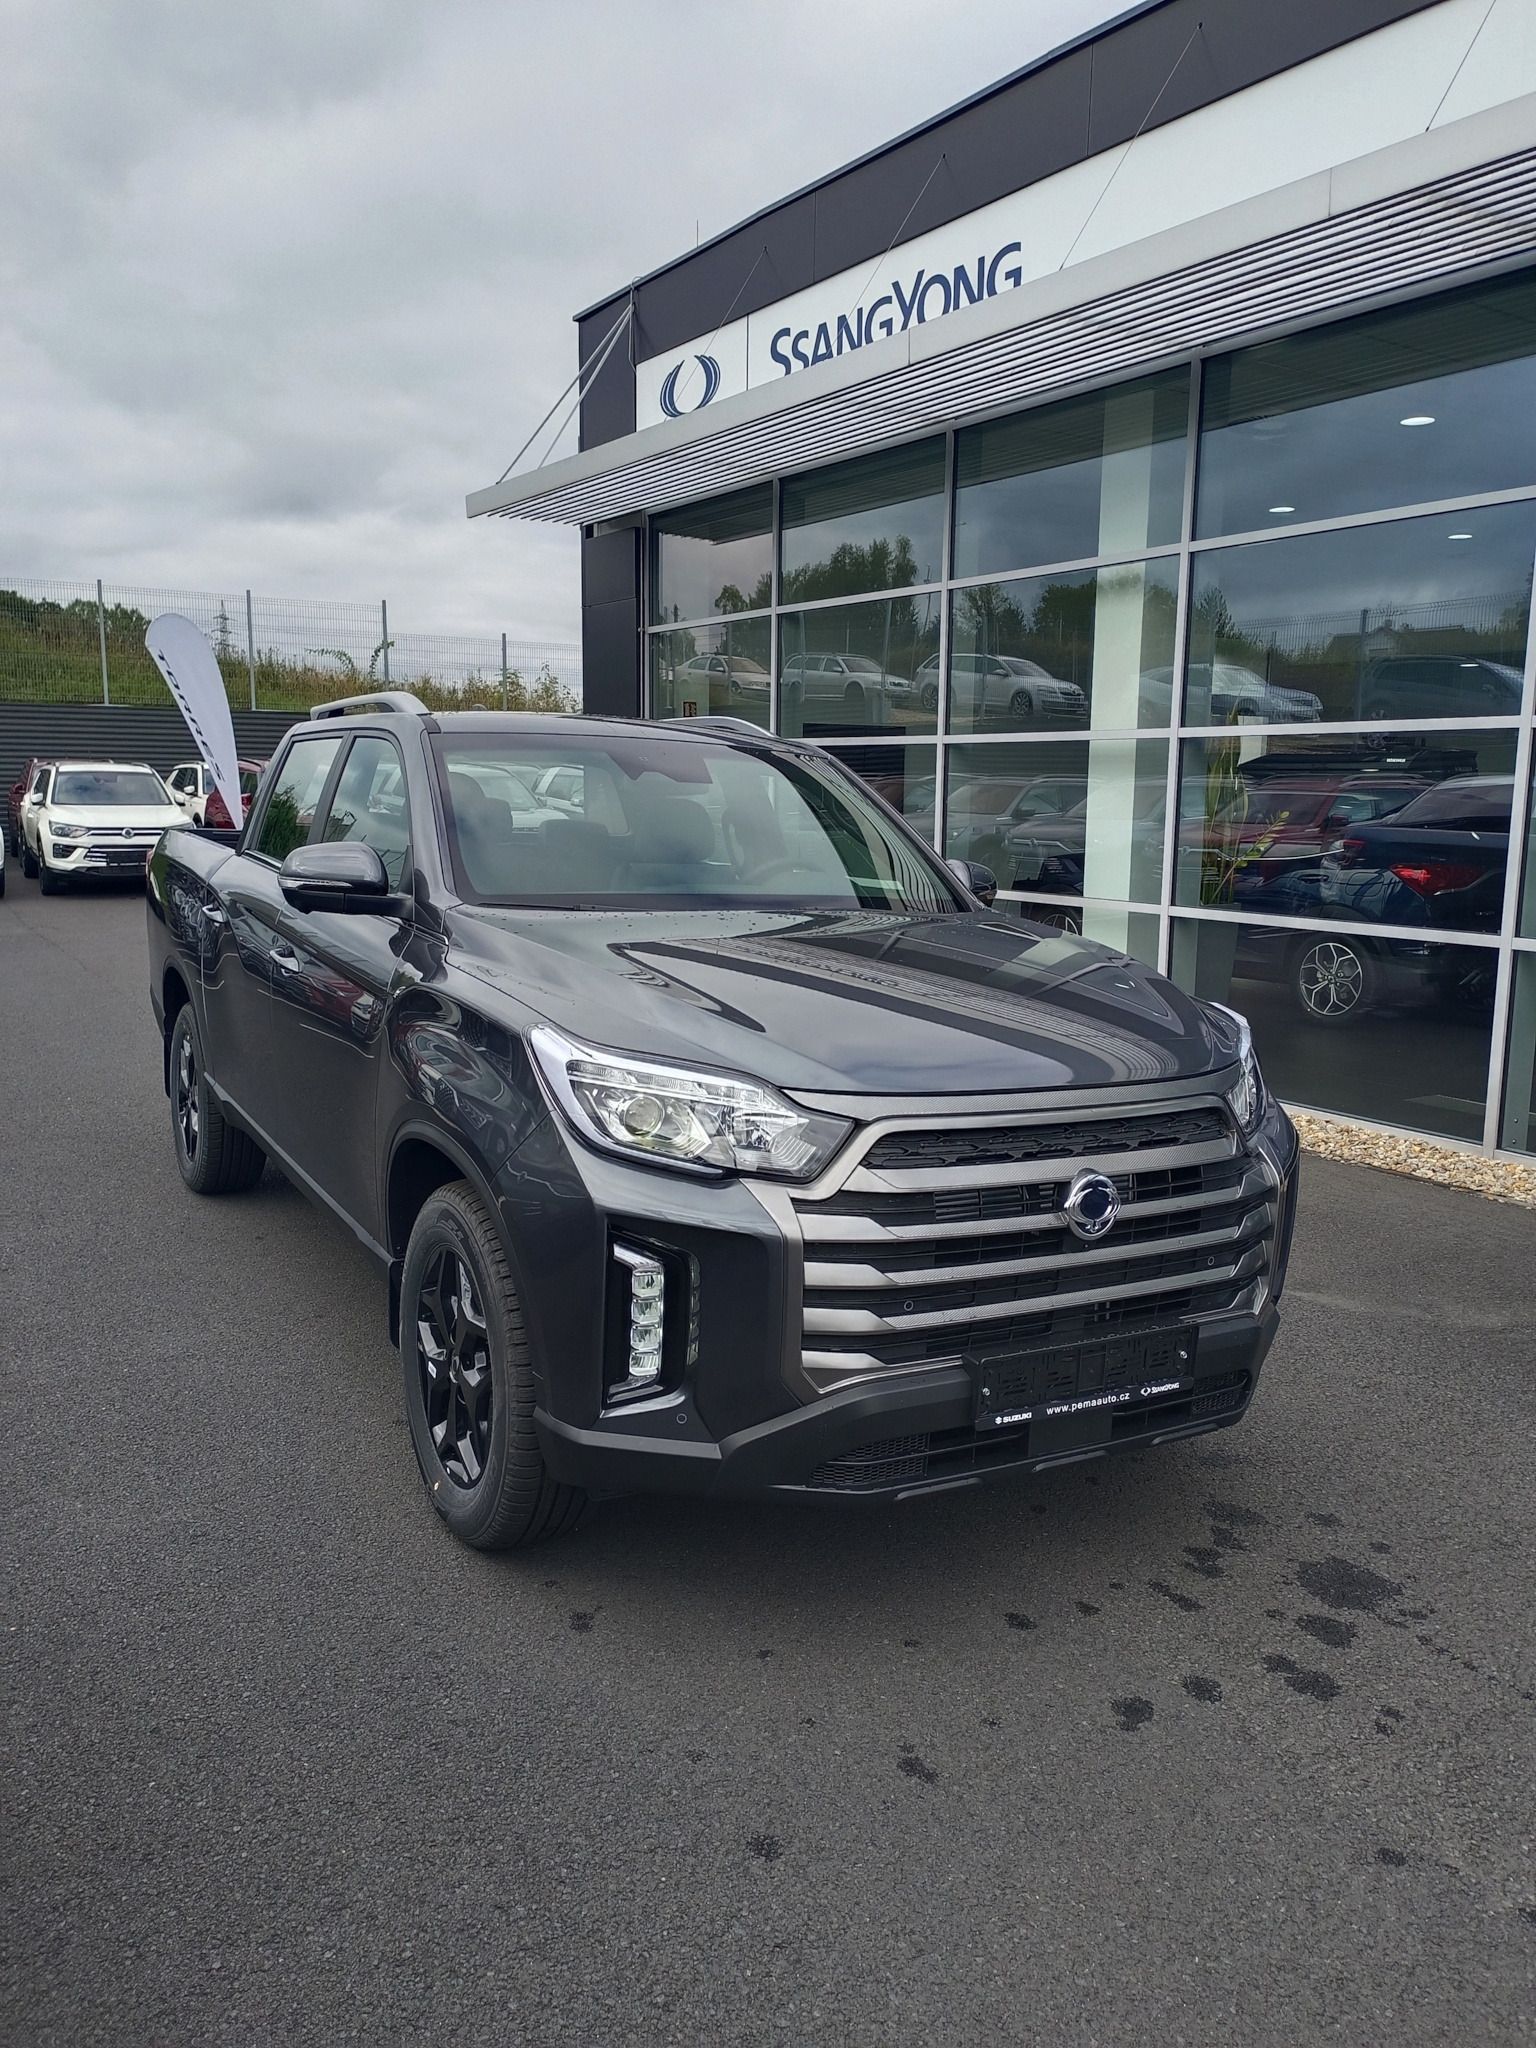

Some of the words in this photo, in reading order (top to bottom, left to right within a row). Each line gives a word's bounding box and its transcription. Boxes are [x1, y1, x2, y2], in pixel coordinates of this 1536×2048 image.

[157, 648, 225, 782] TORRES
[1046, 1392, 1131, 1415] www.pemaauto.cz
[1002, 1412, 1032, 1423] SUZUKI
